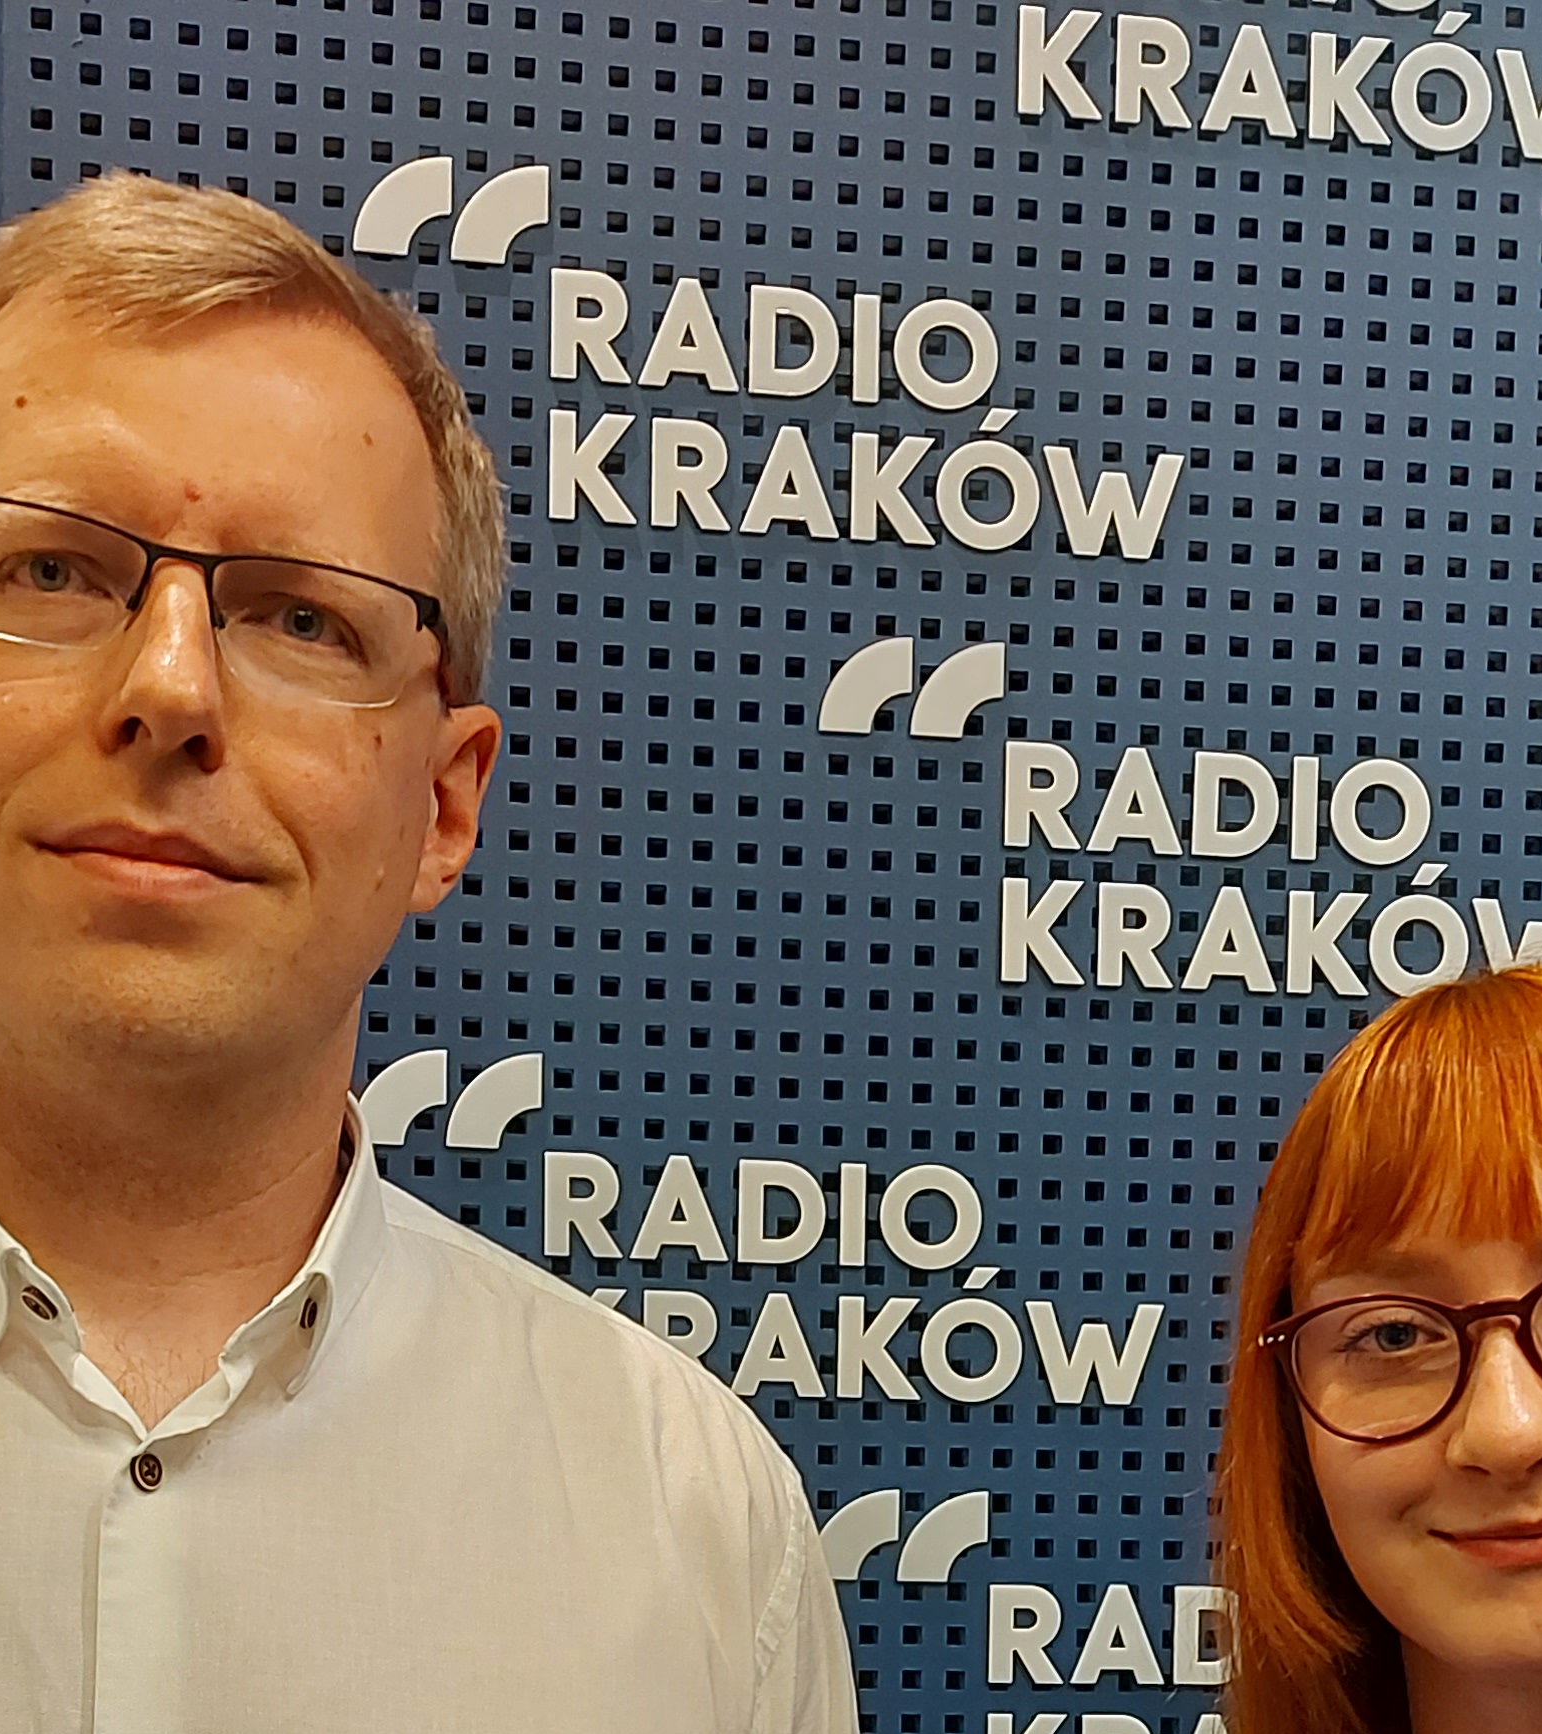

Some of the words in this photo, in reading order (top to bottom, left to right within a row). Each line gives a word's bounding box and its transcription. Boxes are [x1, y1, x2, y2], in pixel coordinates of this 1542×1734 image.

[549, 267, 1000, 411] RADIO
[548, 407, 1186, 560] KRAKÓW
[1002, 739, 1432, 867] RADIO
[542, 1150, 983, 1271] RADIO
[590, 1265, 1166, 1406] RAKÓW
[987, 1583, 1242, 1686] RAD
